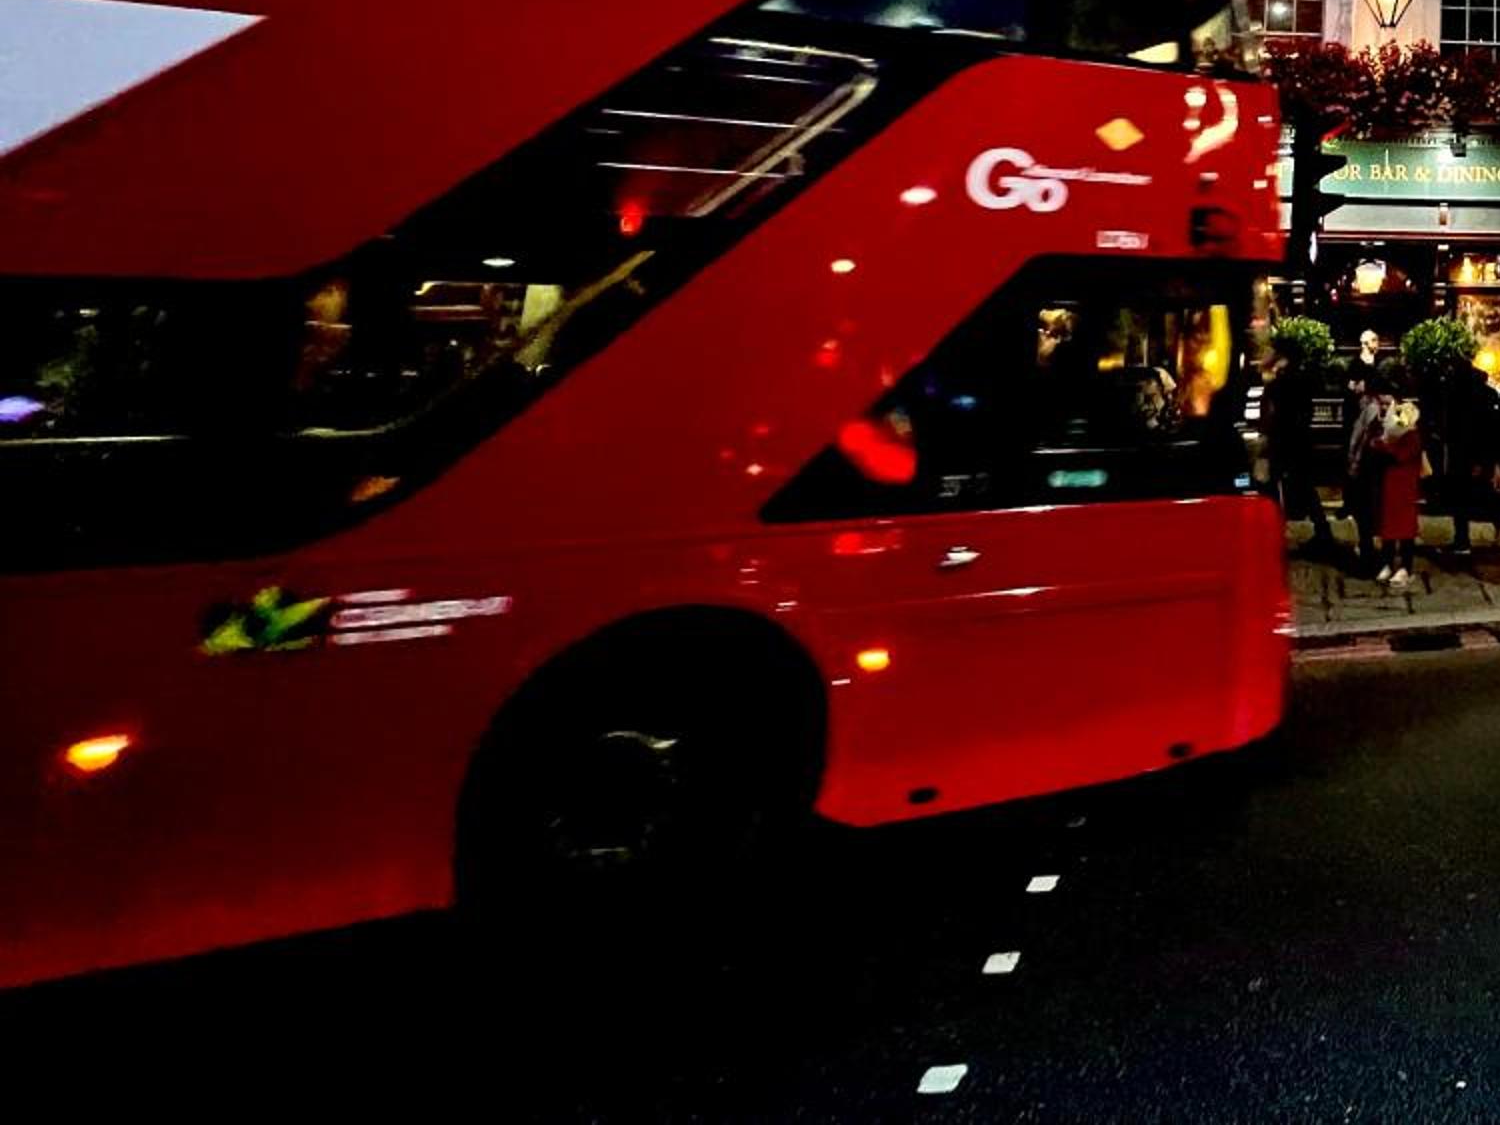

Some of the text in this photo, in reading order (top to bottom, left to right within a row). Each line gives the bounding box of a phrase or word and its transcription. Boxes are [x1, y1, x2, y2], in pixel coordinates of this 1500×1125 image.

[965, 146, 1069, 213] Go
[1369, 163, 1409, 182] BAR
[1414, 165, 1431, 182] &
